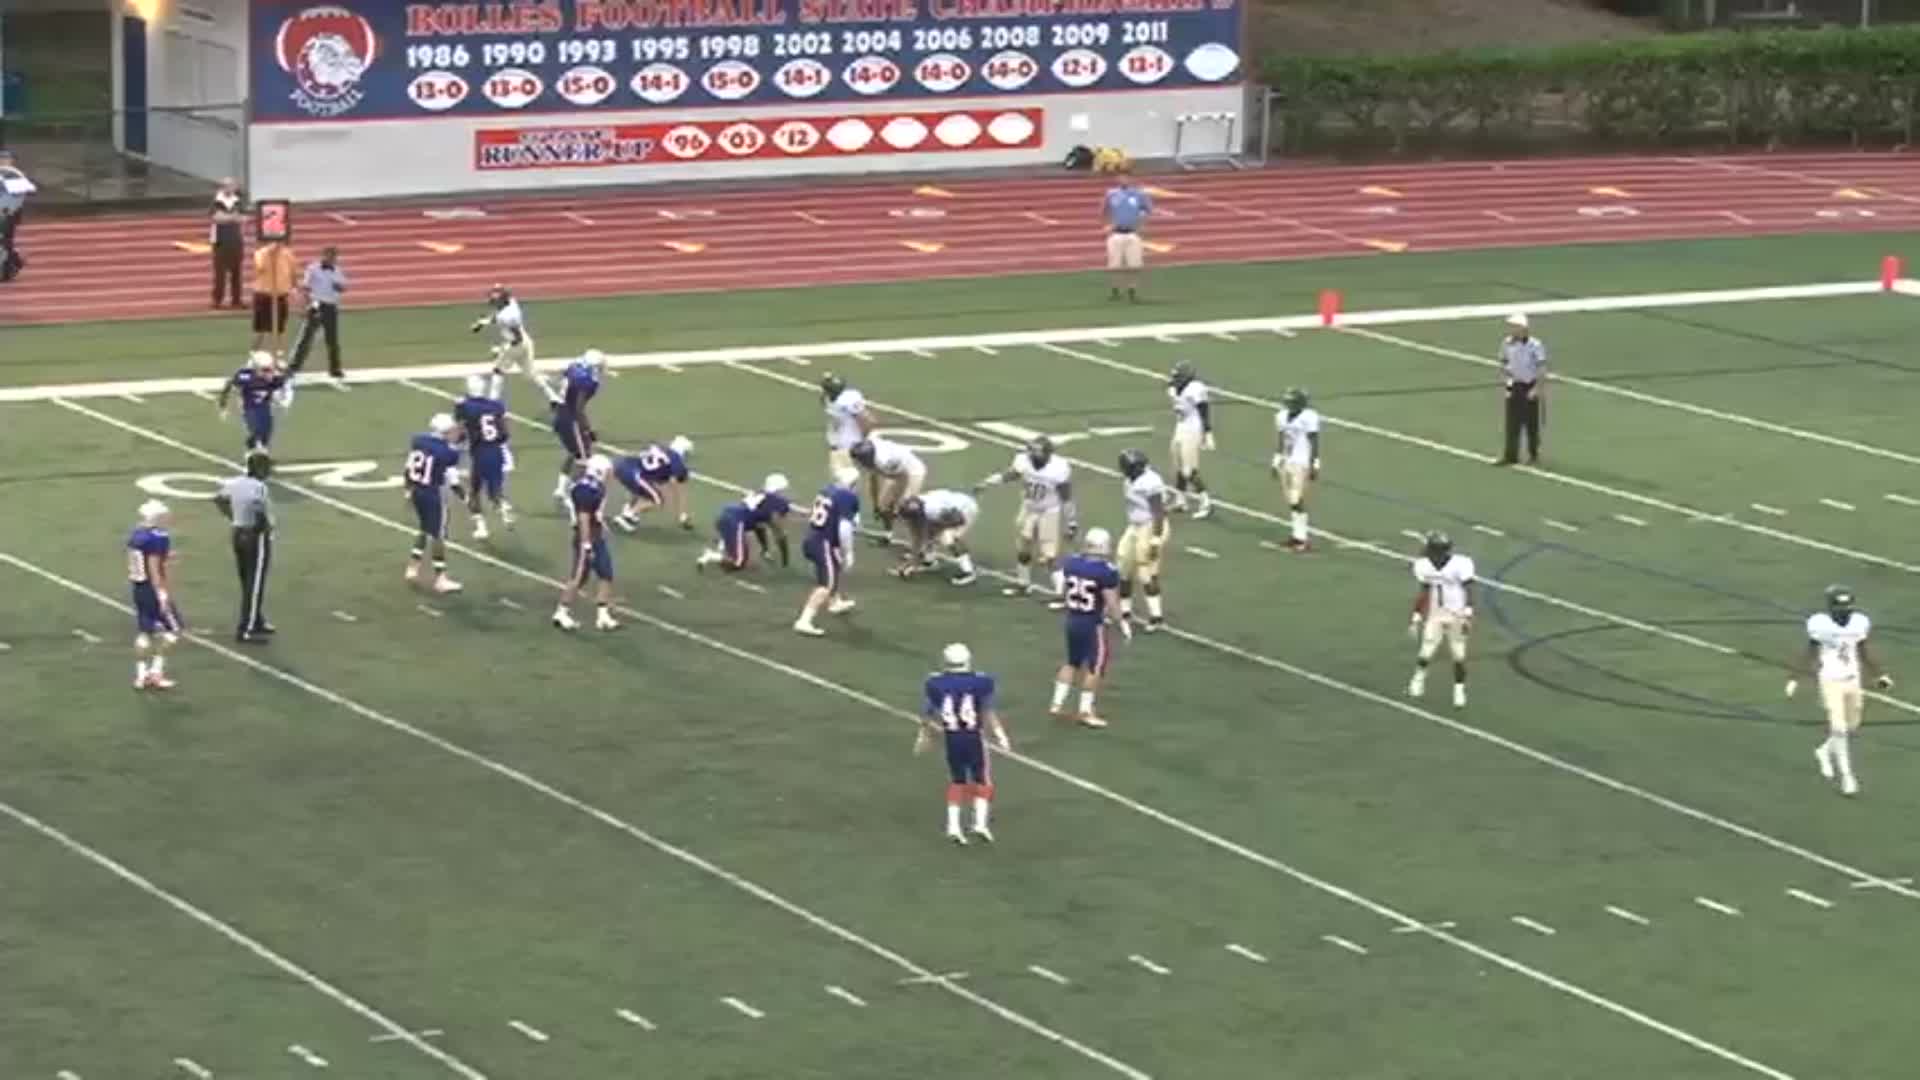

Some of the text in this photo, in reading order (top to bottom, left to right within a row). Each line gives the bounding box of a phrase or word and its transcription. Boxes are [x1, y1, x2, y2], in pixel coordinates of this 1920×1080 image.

[407, 20, 1168, 68] 1986 1990 1993 1995 1998 2002 2004 2006 2008 2009 2011
[1065, 575, 1097, 612] 25
[941, 693, 977, 731] 44
